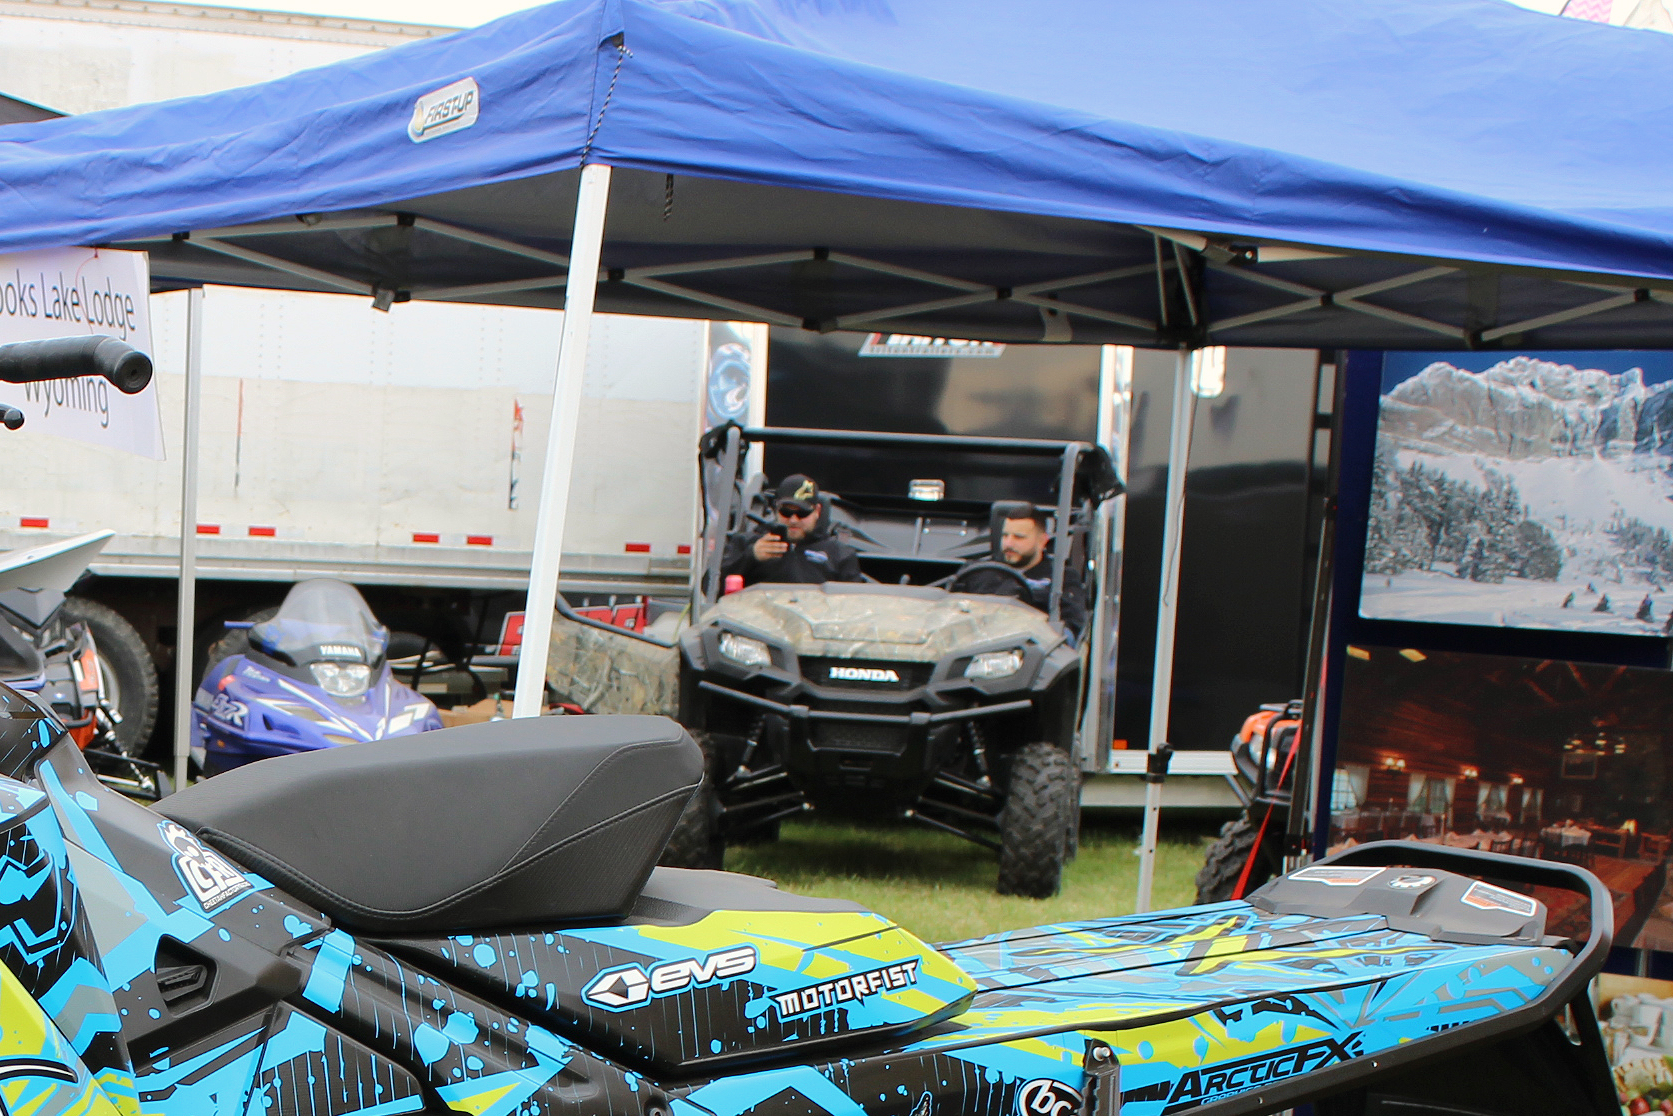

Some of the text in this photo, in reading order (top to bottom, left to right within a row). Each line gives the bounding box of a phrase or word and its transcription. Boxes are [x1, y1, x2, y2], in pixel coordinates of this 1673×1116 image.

[40, 271, 81, 323] Lake
[81, 275, 136, 341] Lodge
[320, 644, 362, 658] YAMAHA
[828, 666, 900, 682] HONDA
[774, 960, 921, 1017] MOTORFIST
